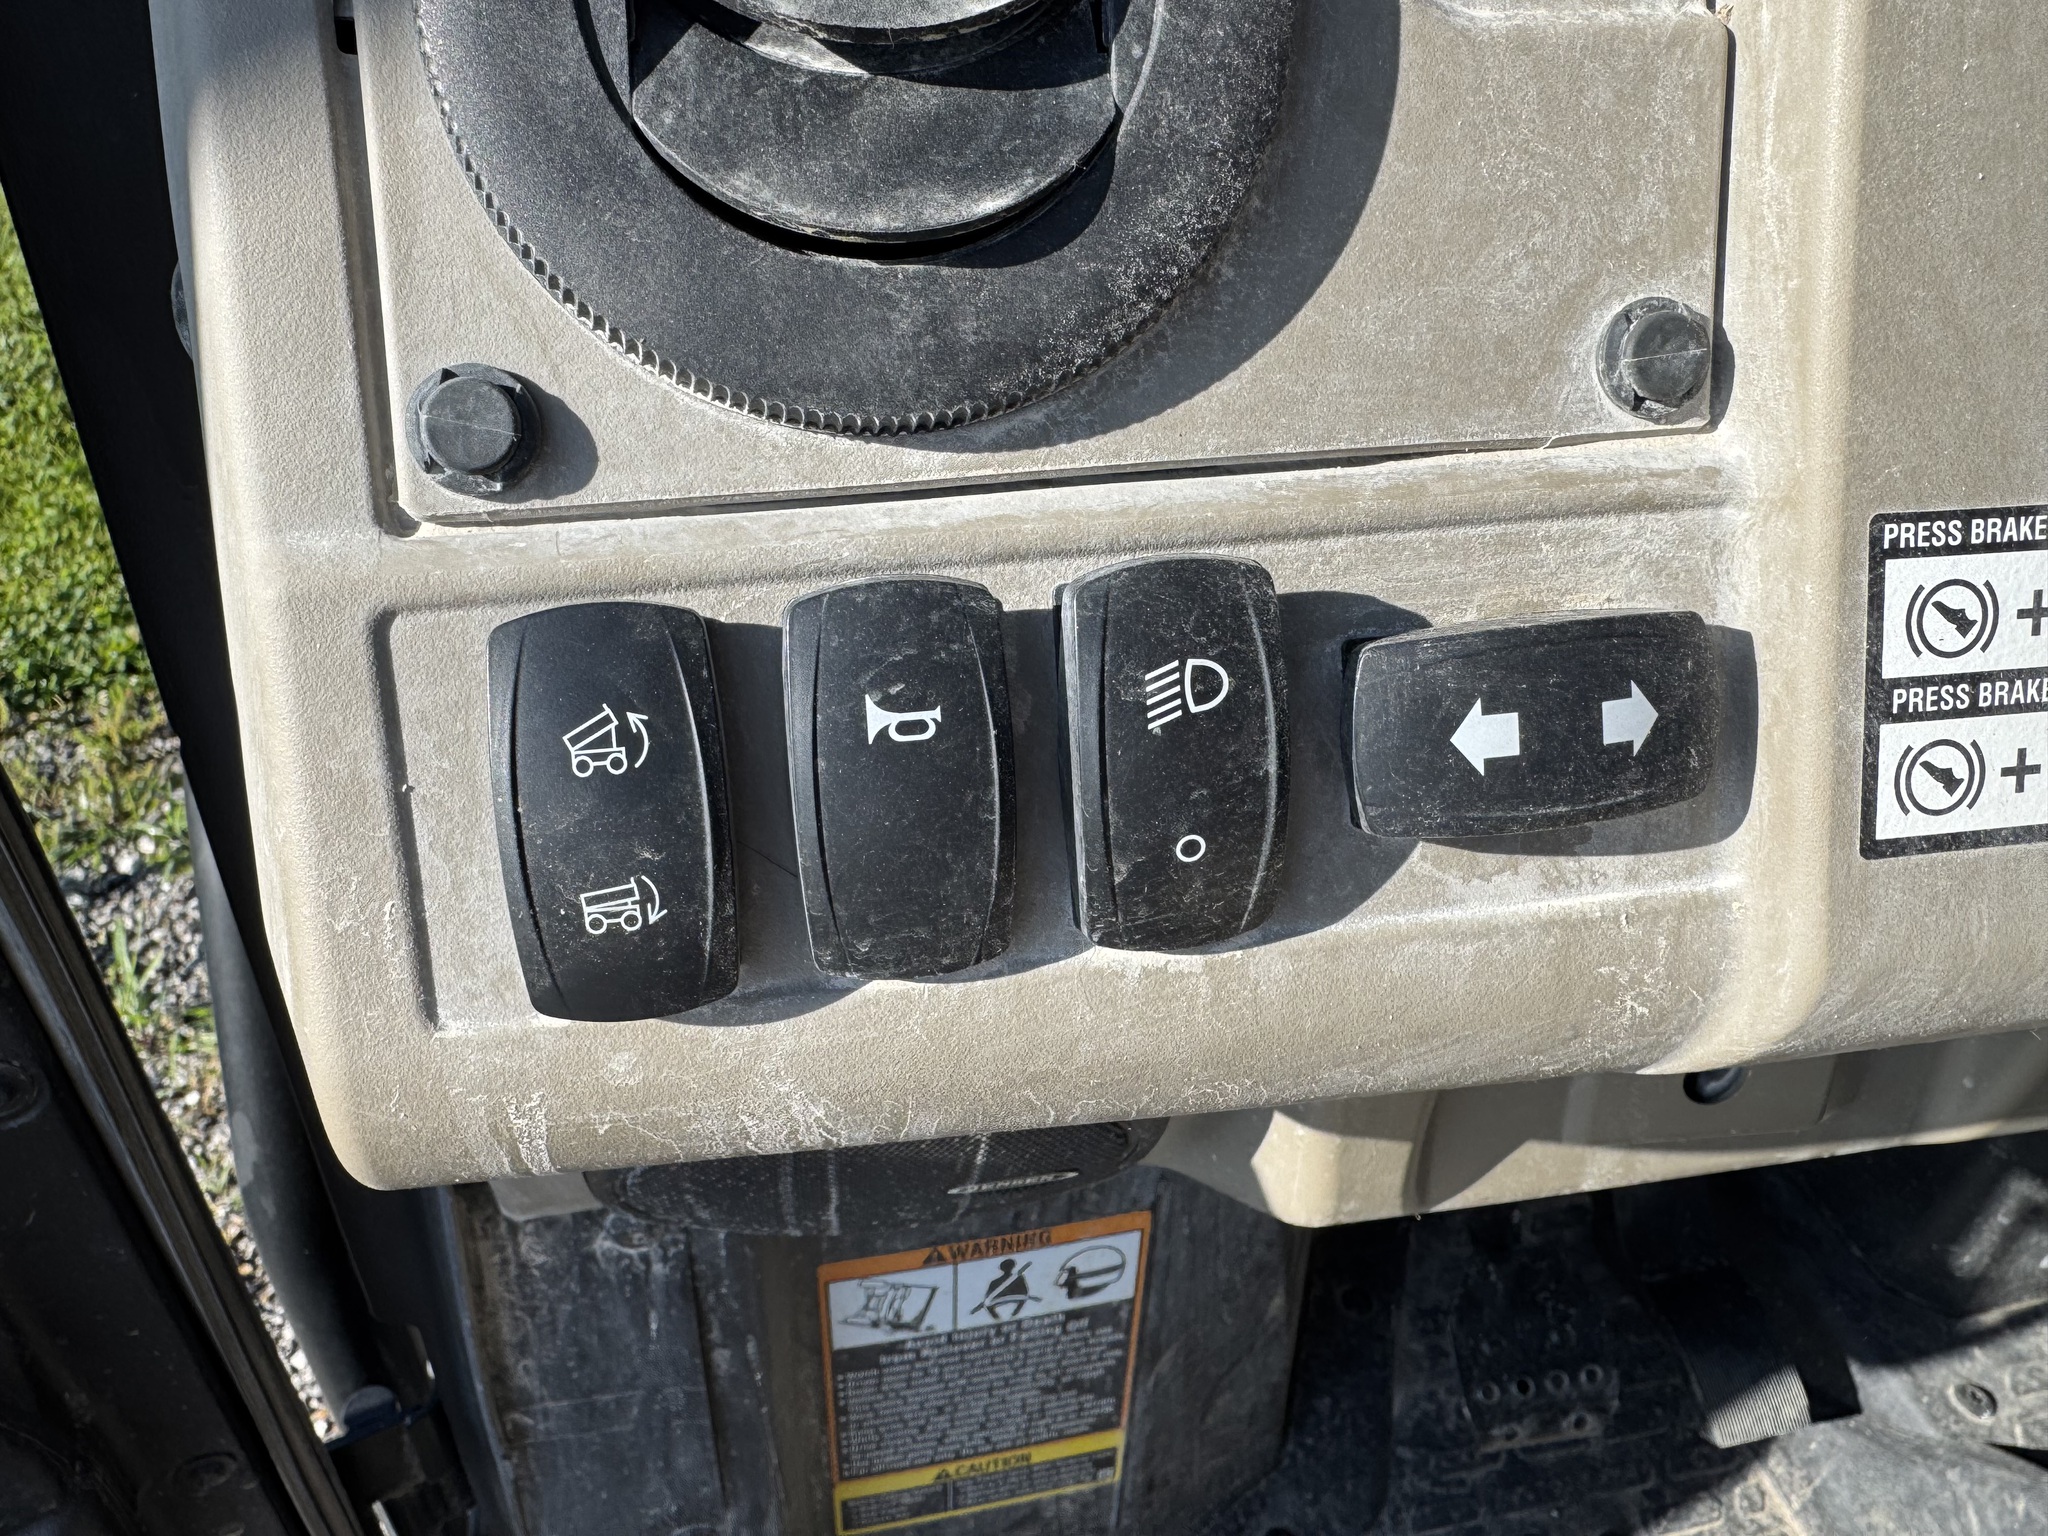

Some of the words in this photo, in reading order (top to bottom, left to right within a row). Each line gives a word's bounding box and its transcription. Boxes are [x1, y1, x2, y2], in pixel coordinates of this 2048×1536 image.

[1883, 519, 1963, 549] PRESS
[1970, 515, 2048, 545] BRAKE
[1892, 683, 1970, 714] PRESS
[949, 1230, 1052, 1260] WARNING
[955, 1452, 1032, 1476] CAUTION
